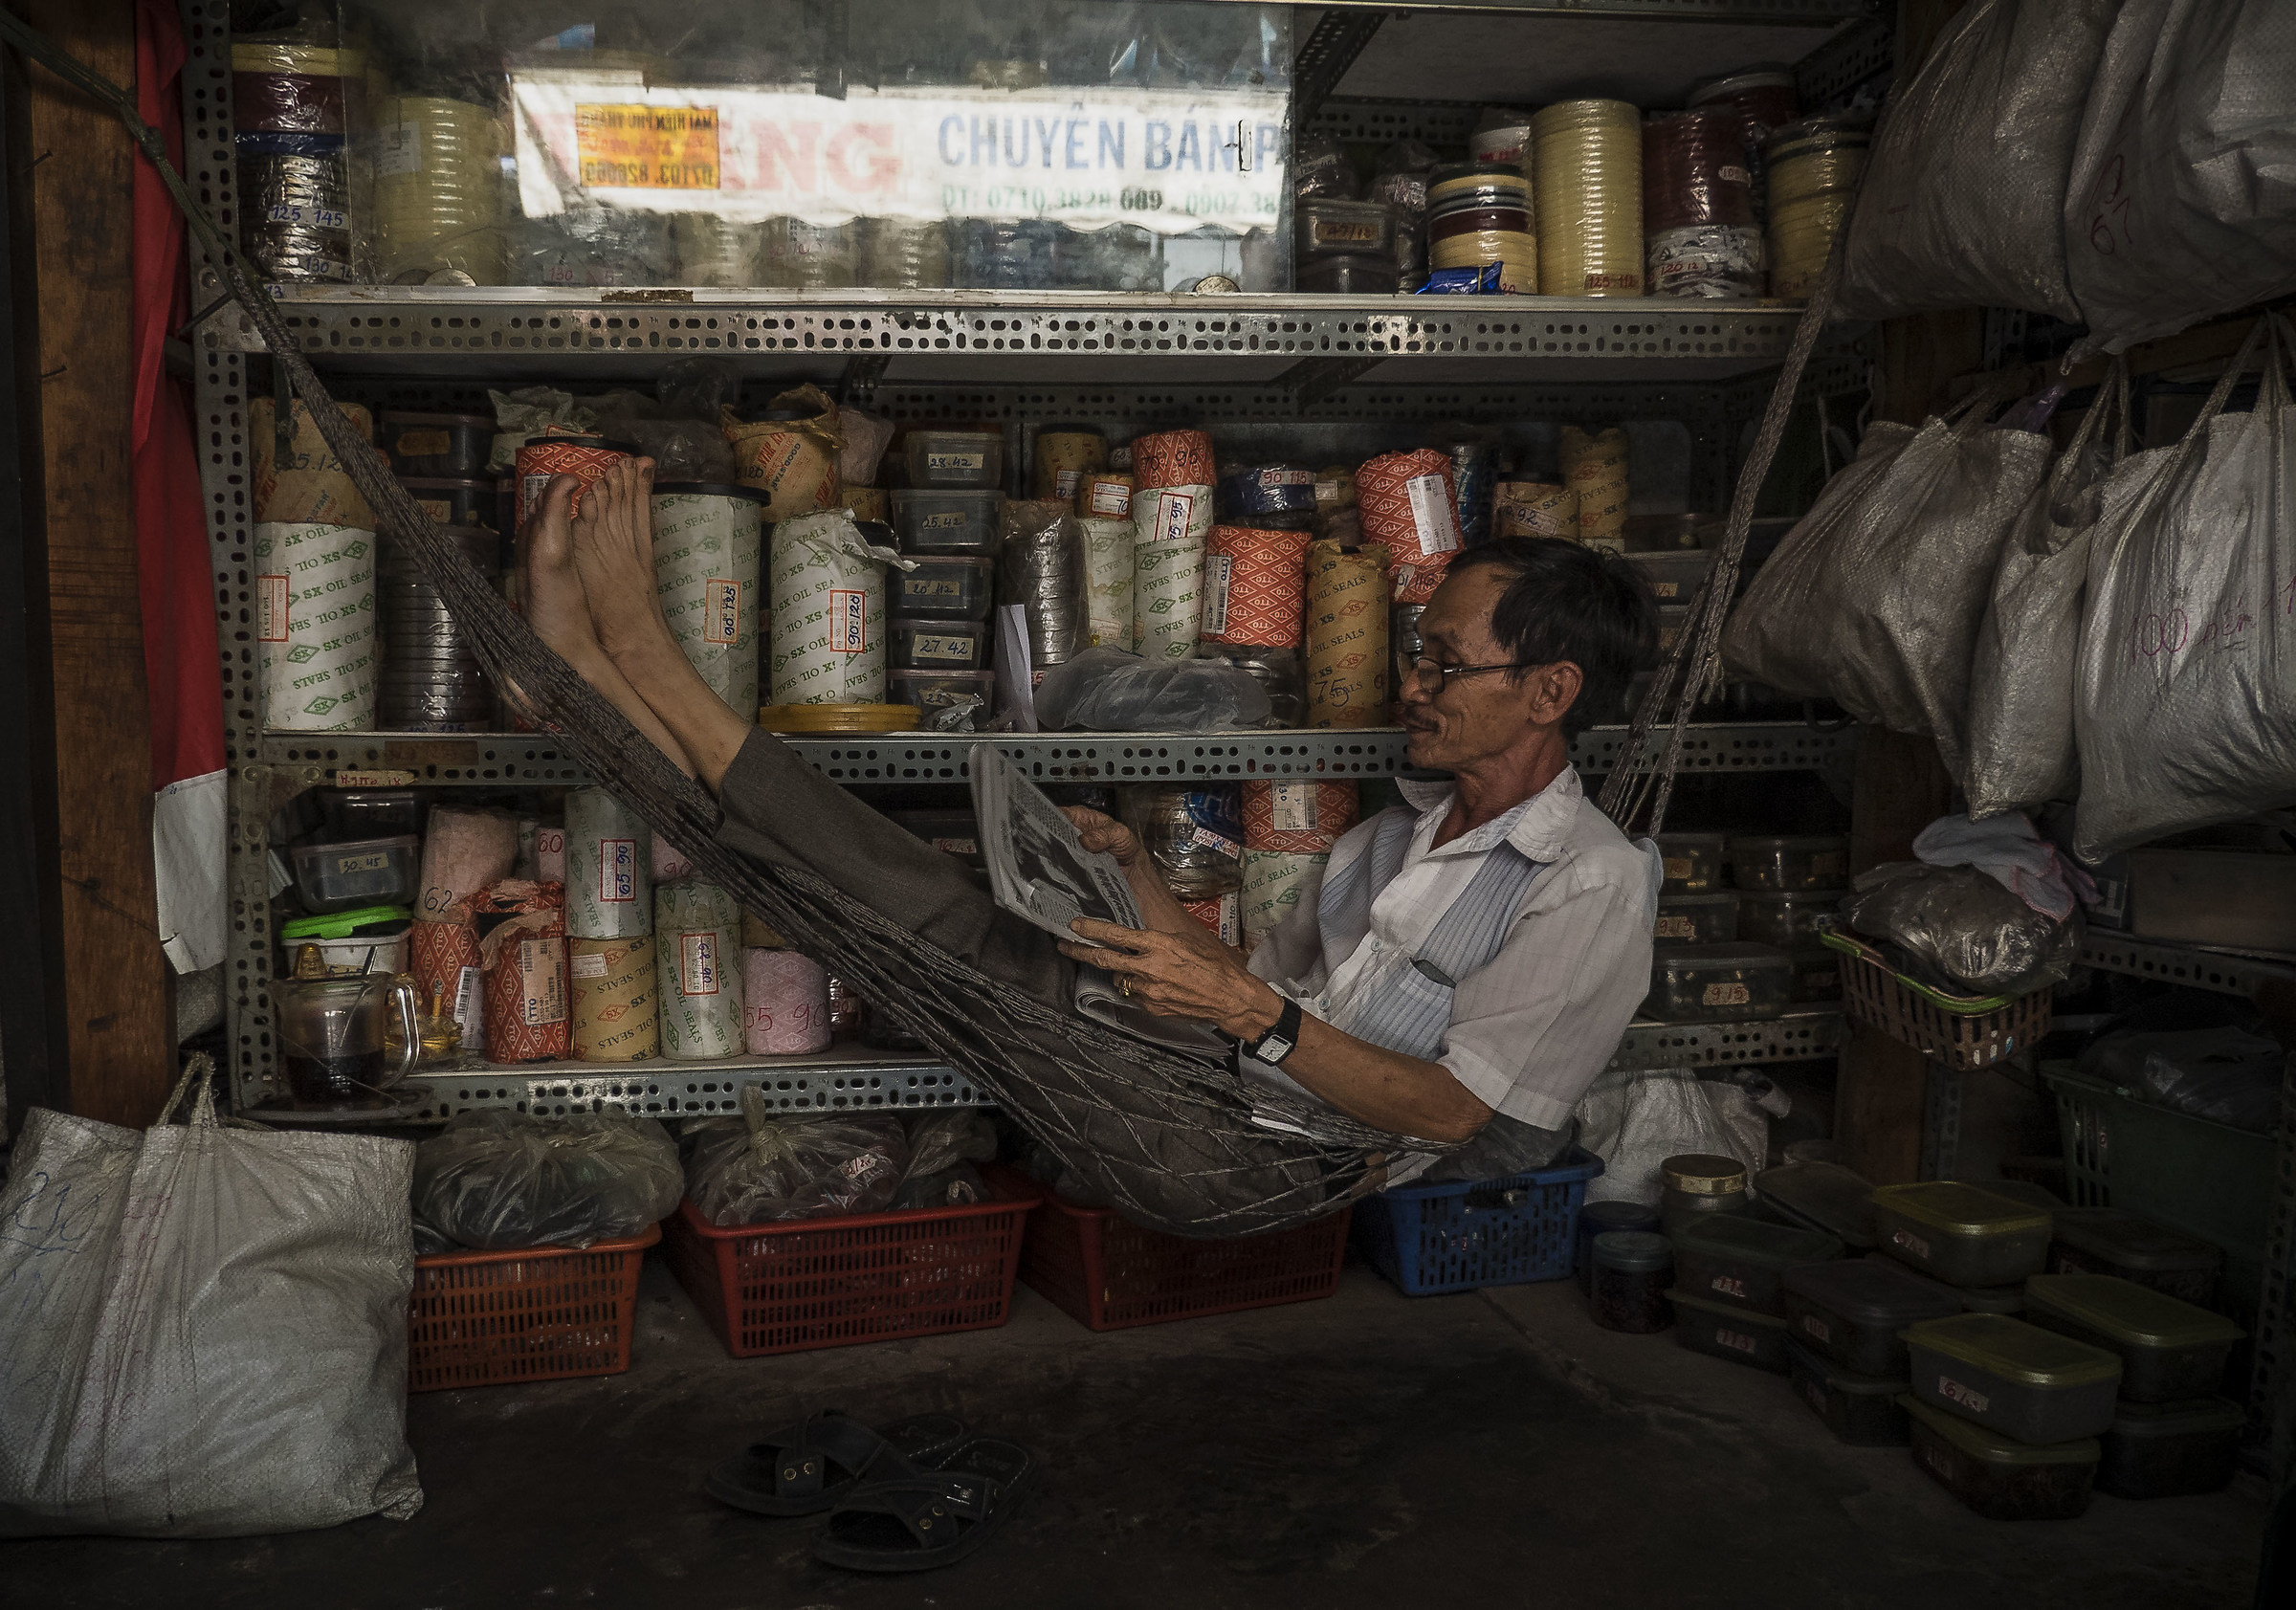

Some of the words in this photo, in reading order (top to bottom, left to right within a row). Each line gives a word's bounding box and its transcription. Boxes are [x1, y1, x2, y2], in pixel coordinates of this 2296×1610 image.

[938, 101, 1126, 170] CHUYÊN
[1144, 104, 1237, 173] BÁN
[271, 205, 302, 221] 125
[314, 209, 344, 227] 145
[1263, 471, 1282, 485] 90
[1290, 472, 1307, 484] 115
[659, 497, 675, 511] SX
[284, 534, 303, 547] SX
[306, 527, 329, 540] OIL
[661, 524, 680, 537] OIL
[796, 526, 828, 544] SEALS
[320, 551, 341, 564] SX
[673, 547, 691, 560] SX
[295, 559, 319, 572] OIL
[788, 562, 805, 577] SX
[1321, 561, 1337, 573] SX
[675, 575, 697, 587] OIL
[1174, 568, 1191, 580] OIL
[302, 586, 323, 600] SX
[326, 579, 348, 592] OIL
[1142, 576, 1170, 592] SEALS
[1314, 590, 1331, 603] OIL
[1332, 575, 1367, 593] SEALS
[779, 598, 791, 612] SX
[792, 588, 812, 603] OIL
[1179, 591, 1194, 604] SX
[316, 610, 338, 624] OIL
[341, 604, 357, 617] SX
[805, 611, 823, 625] SX
[785, 620, 803, 633] OIL
[1319, 612, 1335, 626] SX
[1154, 620, 1184, 636] SEALS
[322, 638, 342, 651] SX
[790, 646, 806, 659] SX
[808, 636, 829, 651] OIL
[919, 638, 968, 655] 27.42
[1313, 642, 1329, 654] OIL
[1331, 629, 1365, 647] SEALS
[334, 664, 355, 676] OIL
[800, 668, 820, 682] OIL
[293, 671, 331, 690] SEALS
[341, 689, 357, 703] SX
[1314, 677, 1349, 708] 75
[539, 832, 563, 853] 60
[1249, 877, 1266, 891] OIL
[1267, 864, 1298, 882] SEALS
[424, 886, 453, 914] 62
[1260, 899, 1274, 912] SX
[597, 973, 634, 994] SEALS
[630, 994, 646, 1008] SX
[674, 986, 688, 1006] OIL
[683, 1010, 703, 1044] SEALS
[746, 1006, 773, 1032] 55
[598, 1028, 634, 1049] SEALS
